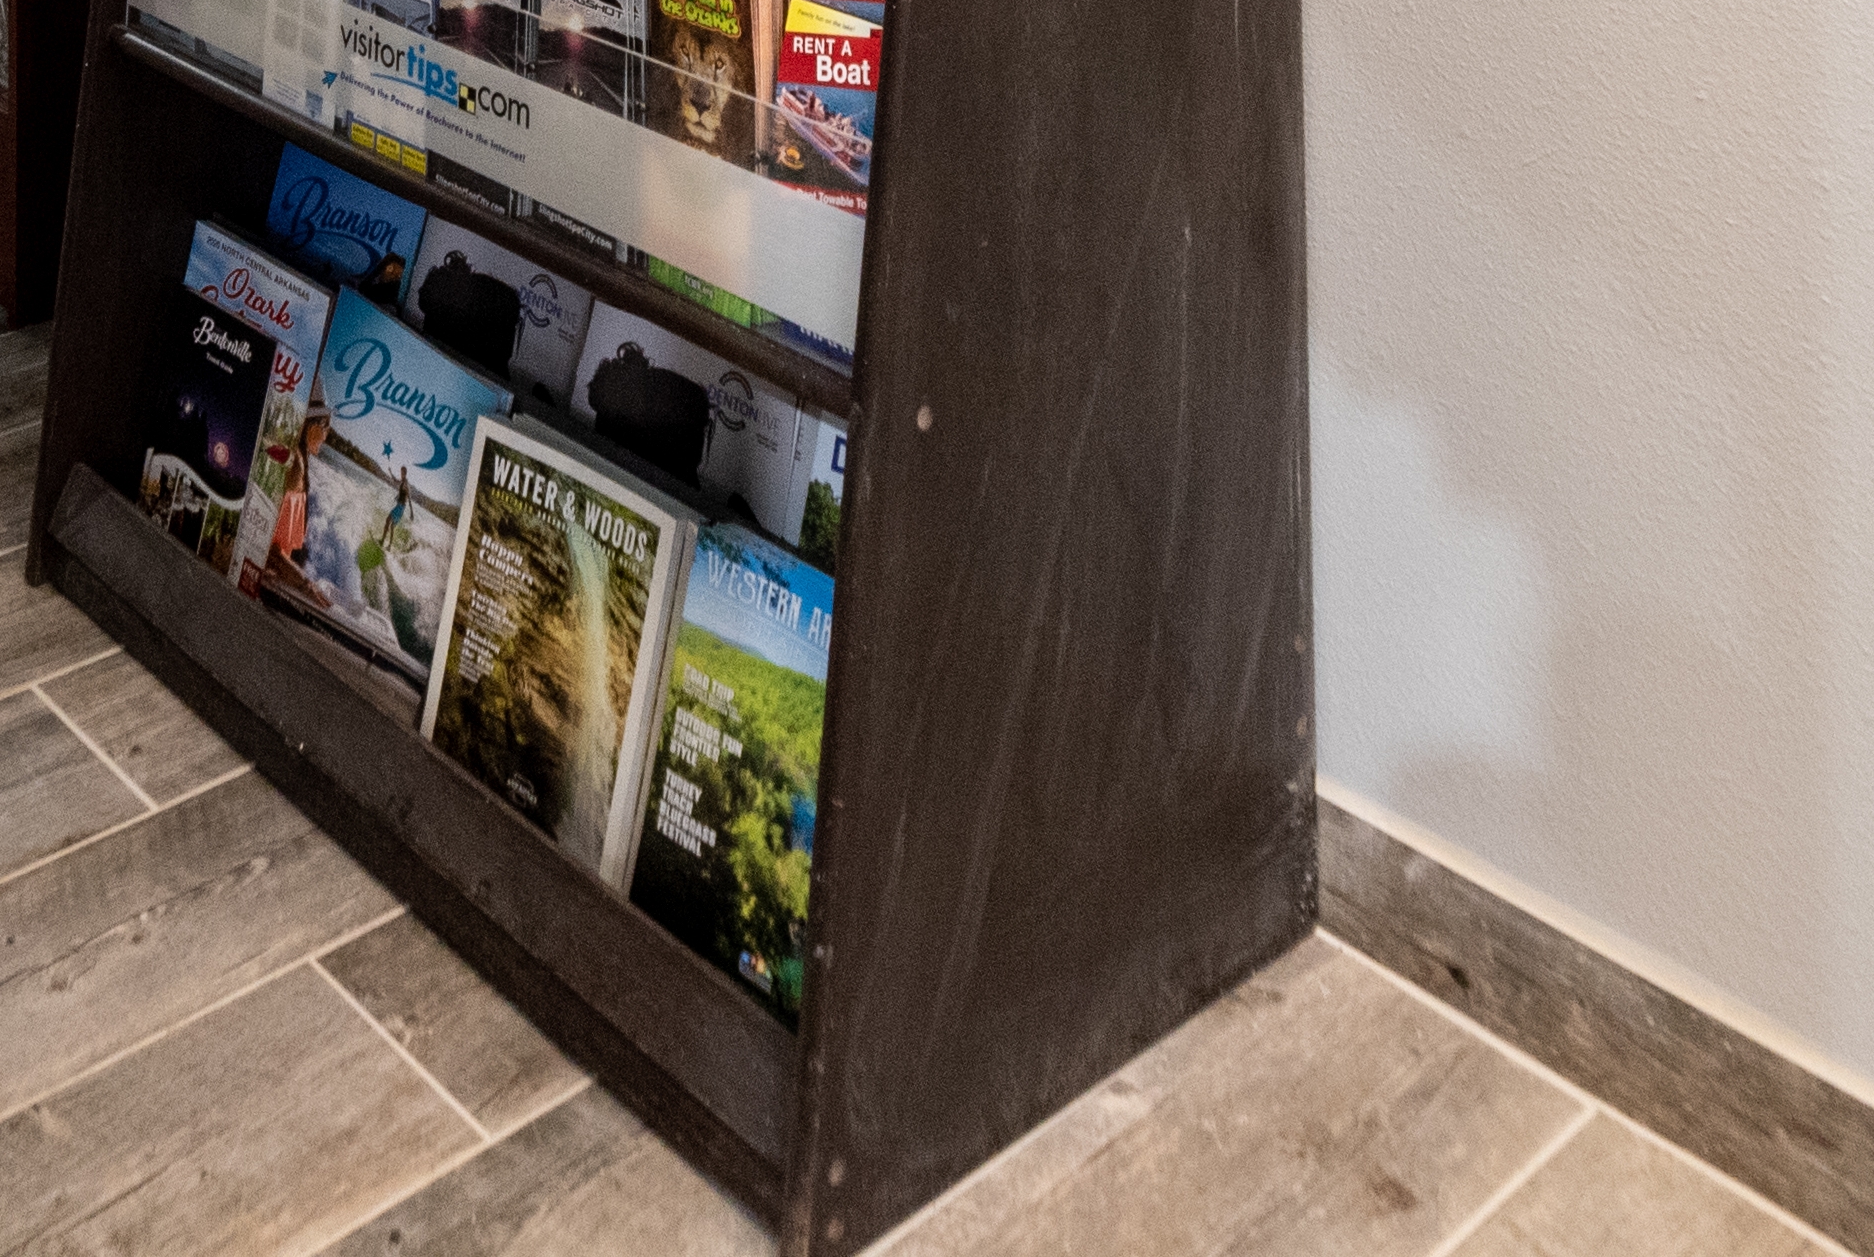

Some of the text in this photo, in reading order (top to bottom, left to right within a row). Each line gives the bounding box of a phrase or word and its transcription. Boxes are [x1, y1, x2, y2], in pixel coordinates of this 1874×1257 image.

[793, 36, 852, 57] RENT A
[816, 55, 871, 85] Boat
[340, 71, 377, 96] Delivering
[377, 87, 389, 102] the
[390, 93, 414, 113] Power
[417, 107, 425, 116] of
[426, 110, 463, 135] Brochures
[465, 127, 474, 140] to
[476, 133, 489, 147] the
[280, 175, 399, 253] Branson
[818, 193, 854, 209] Towable
[222, 241, 245, 265] NORTH
[245, 254, 274, 281] CENTRAL
[274, 269, 311, 302] ARKANSAS
[222, 267, 294, 330] Ozark
[193, 315, 252, 363] Bentonville
[333, 337, 469, 450] Branson
[491, 453, 558, 513] WATER
[562, 490, 577, 523] &
[584, 500, 649, 562] WOODS
[707, 550, 833, 649] WESTERN AR
[657, 816, 701, 857] FESTIVAL
